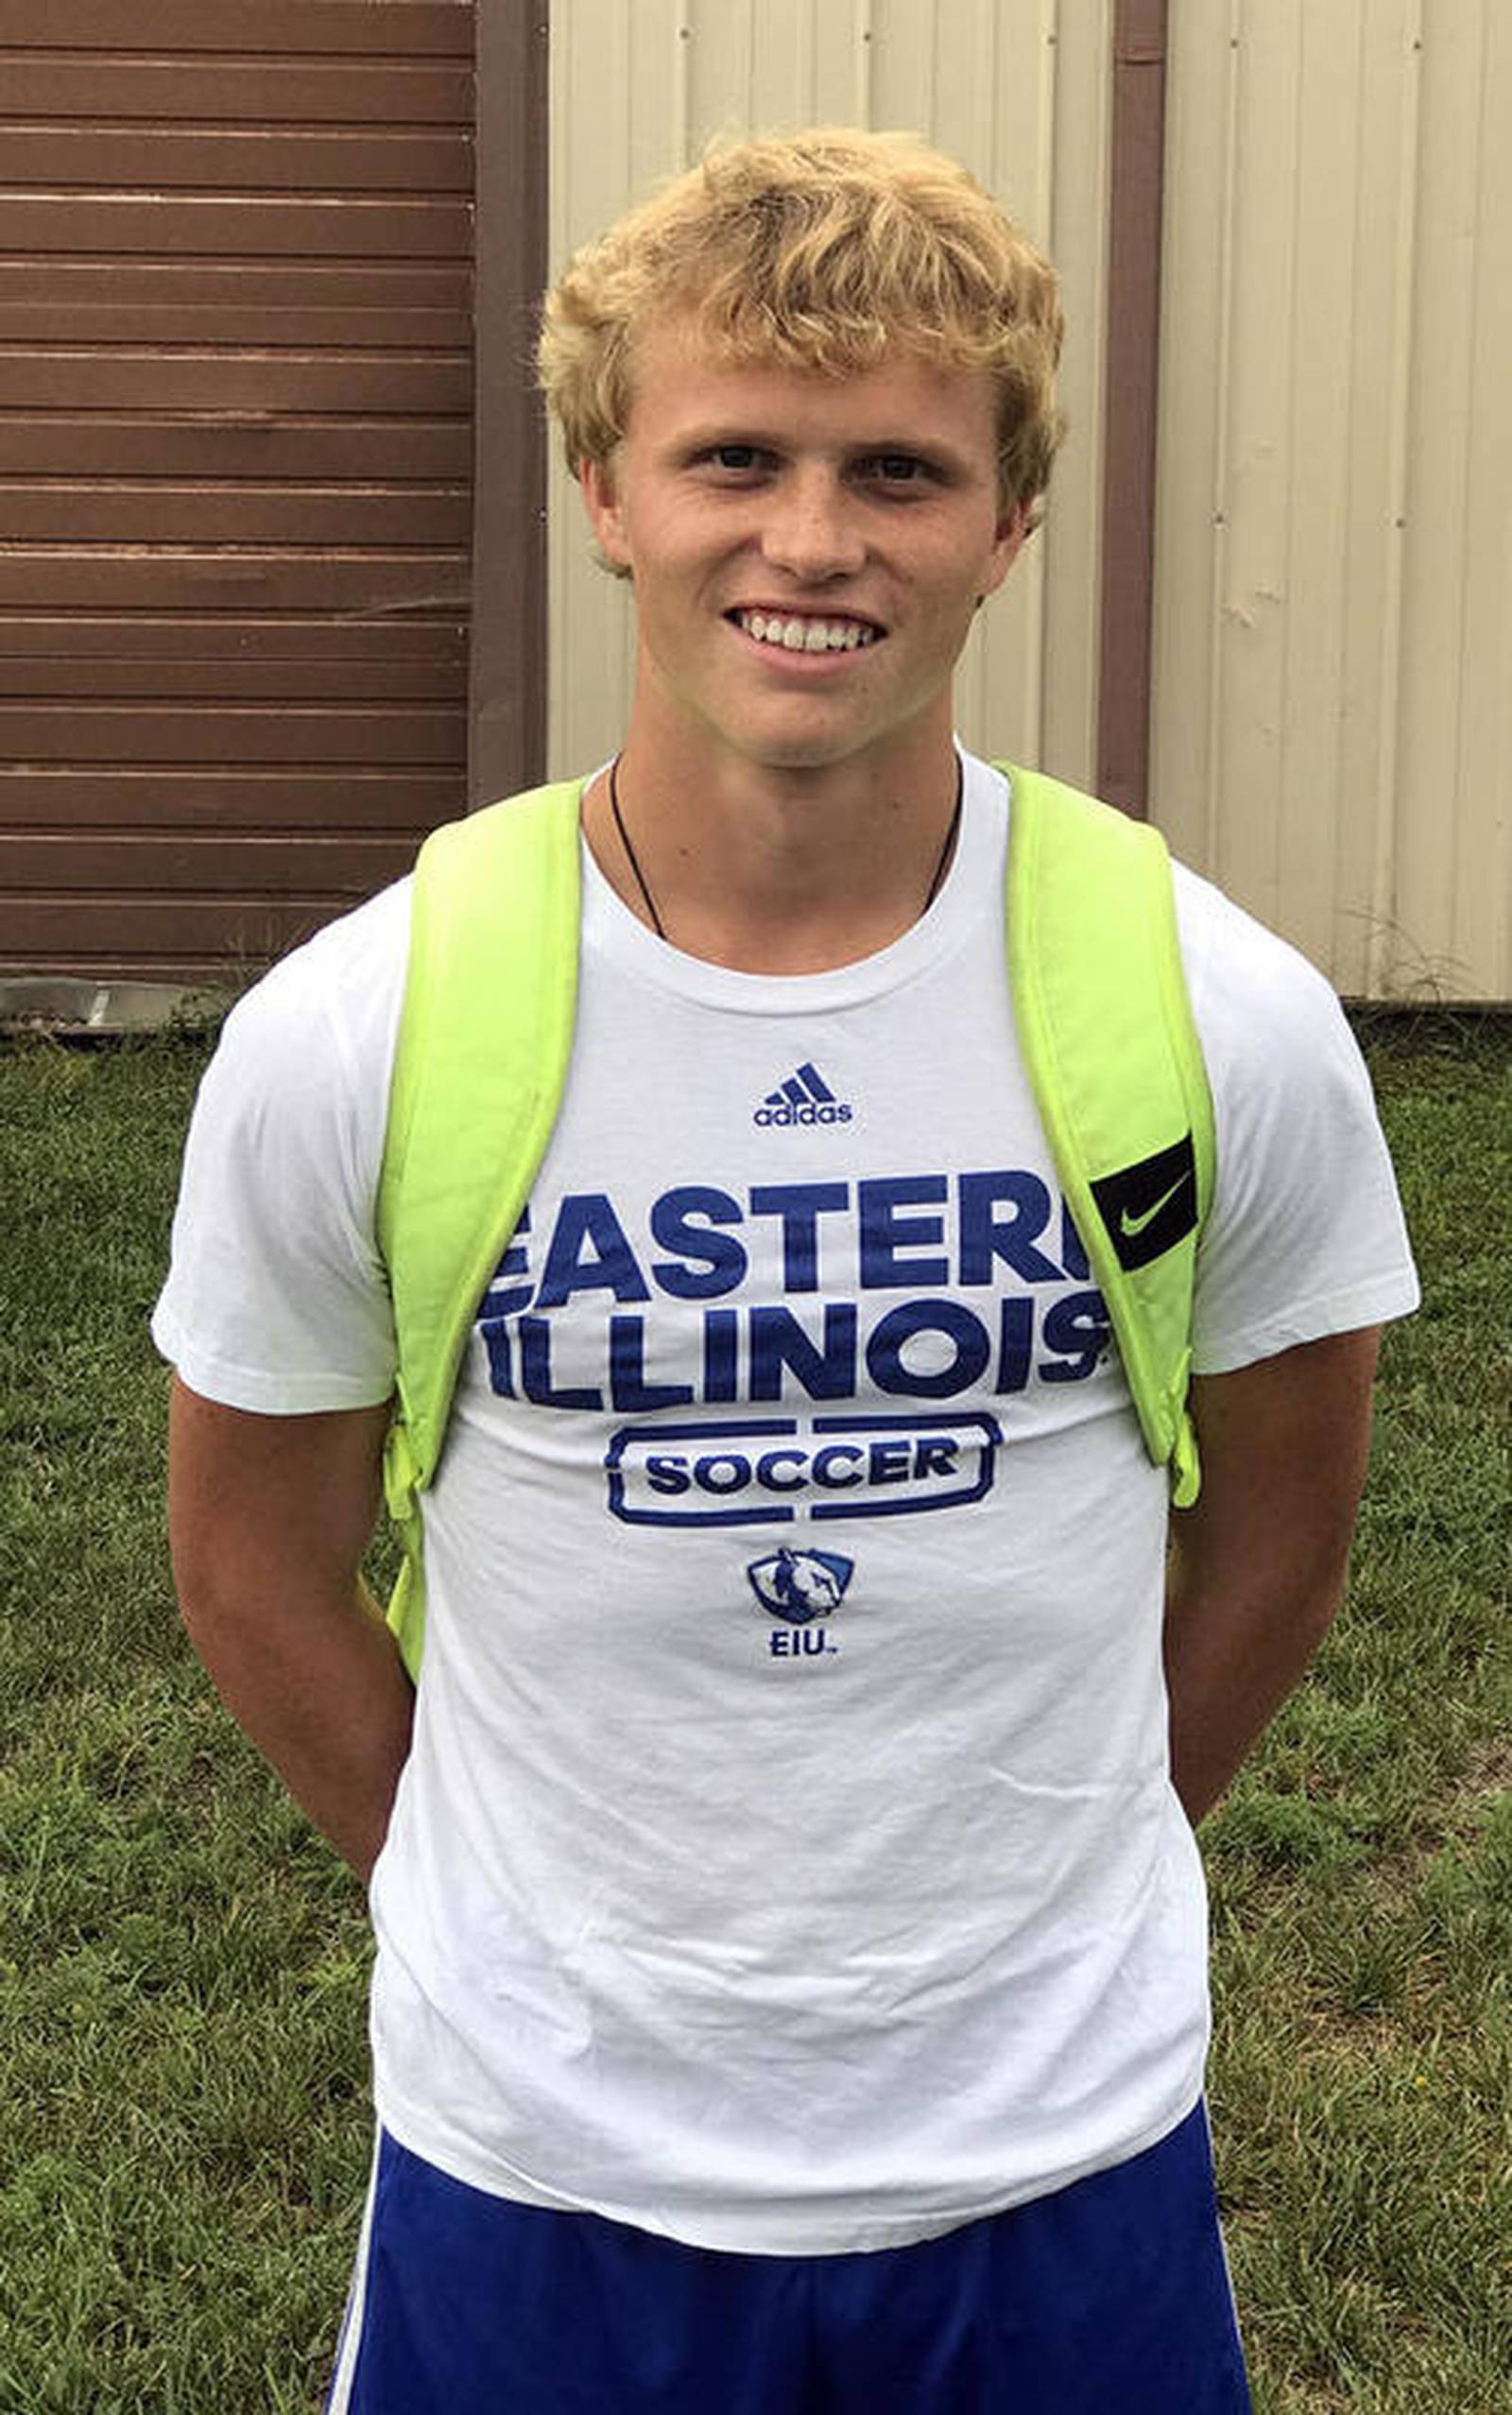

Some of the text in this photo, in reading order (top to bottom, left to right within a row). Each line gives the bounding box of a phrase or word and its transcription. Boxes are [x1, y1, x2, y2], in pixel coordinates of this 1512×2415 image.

[754, 1103, 852, 1127] adidas
[477, 1170, 1091, 1320] EASTER
[479, 1289, 1111, 1413] ILLINOIS
[645, 1437, 959, 1495] SOCCER
